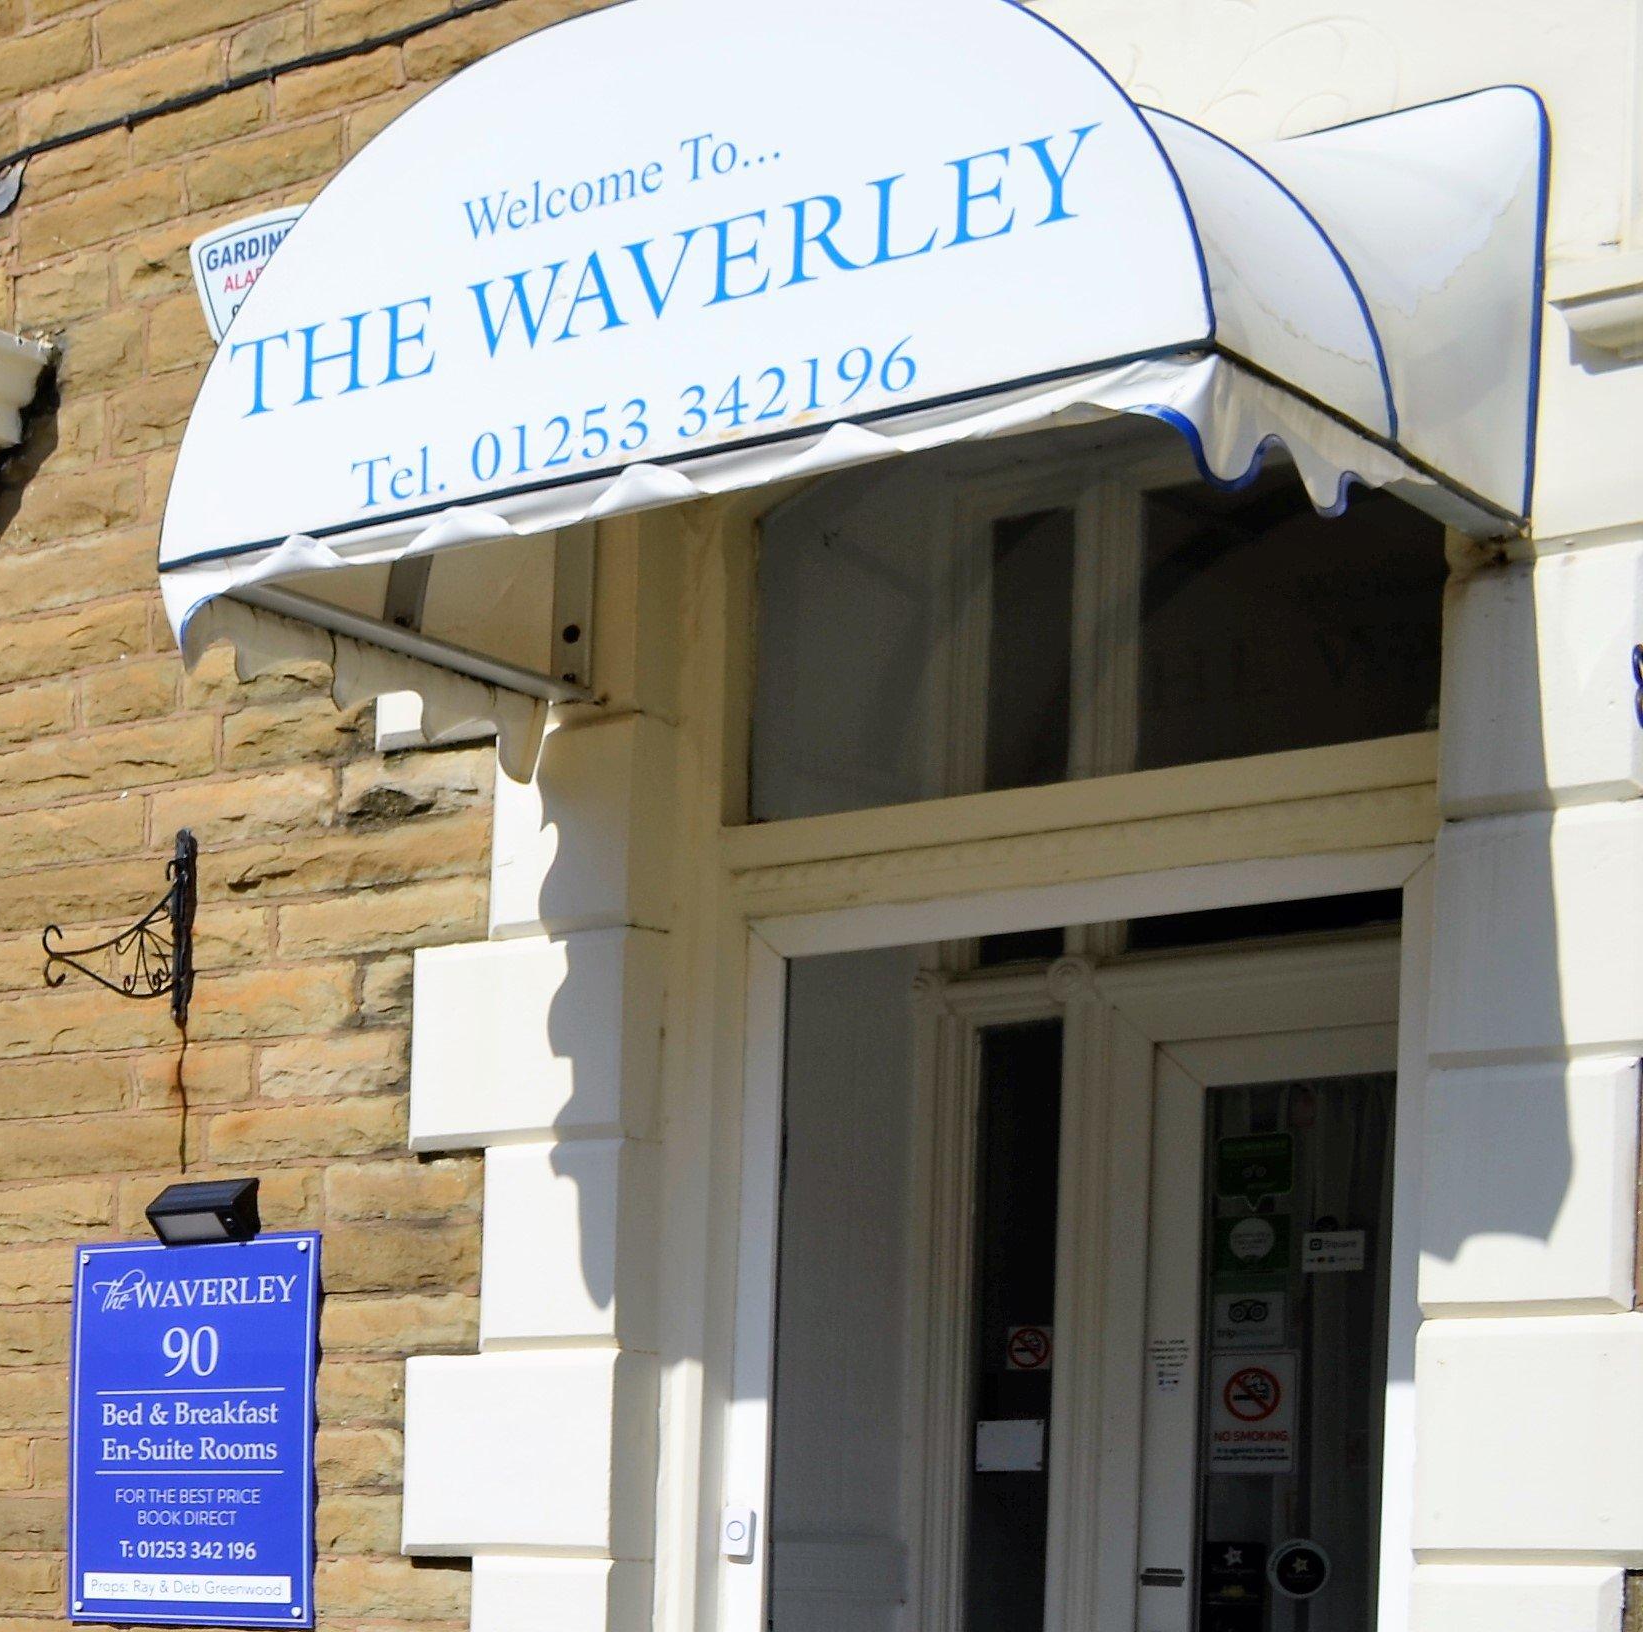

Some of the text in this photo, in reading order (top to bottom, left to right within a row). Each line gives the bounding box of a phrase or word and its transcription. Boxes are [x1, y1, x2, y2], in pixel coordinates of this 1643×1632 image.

[464, 133, 781, 239] Welcome To...
[230, 122, 1102, 419] THE WAVERLEY
[351, 335, 917, 509] Tel. 01253 342196
[92, 1268, 298, 1313] The WAVERLEY
[162, 1325, 219, 1377] 90
[101, 1400, 280, 1426] Bed & Breakfast
[1214, 1430, 1289, 1441] NO SMOKING
[101, 1437, 278, 1461] En-Suite Rooms
[115, 1488, 261, 1504] FOR THE BEST PRICE
[137, 1510, 237, 1526] BOOK DIRECT
[119, 1540, 257, 1560] T: 01253 342 196
[133, 1580, 155, 1596] Ray
[159, 1579, 168, 1593] &
[173, 1580, 200, 1594] Deb
[204, 1580, 282, 1597] Greenwood
